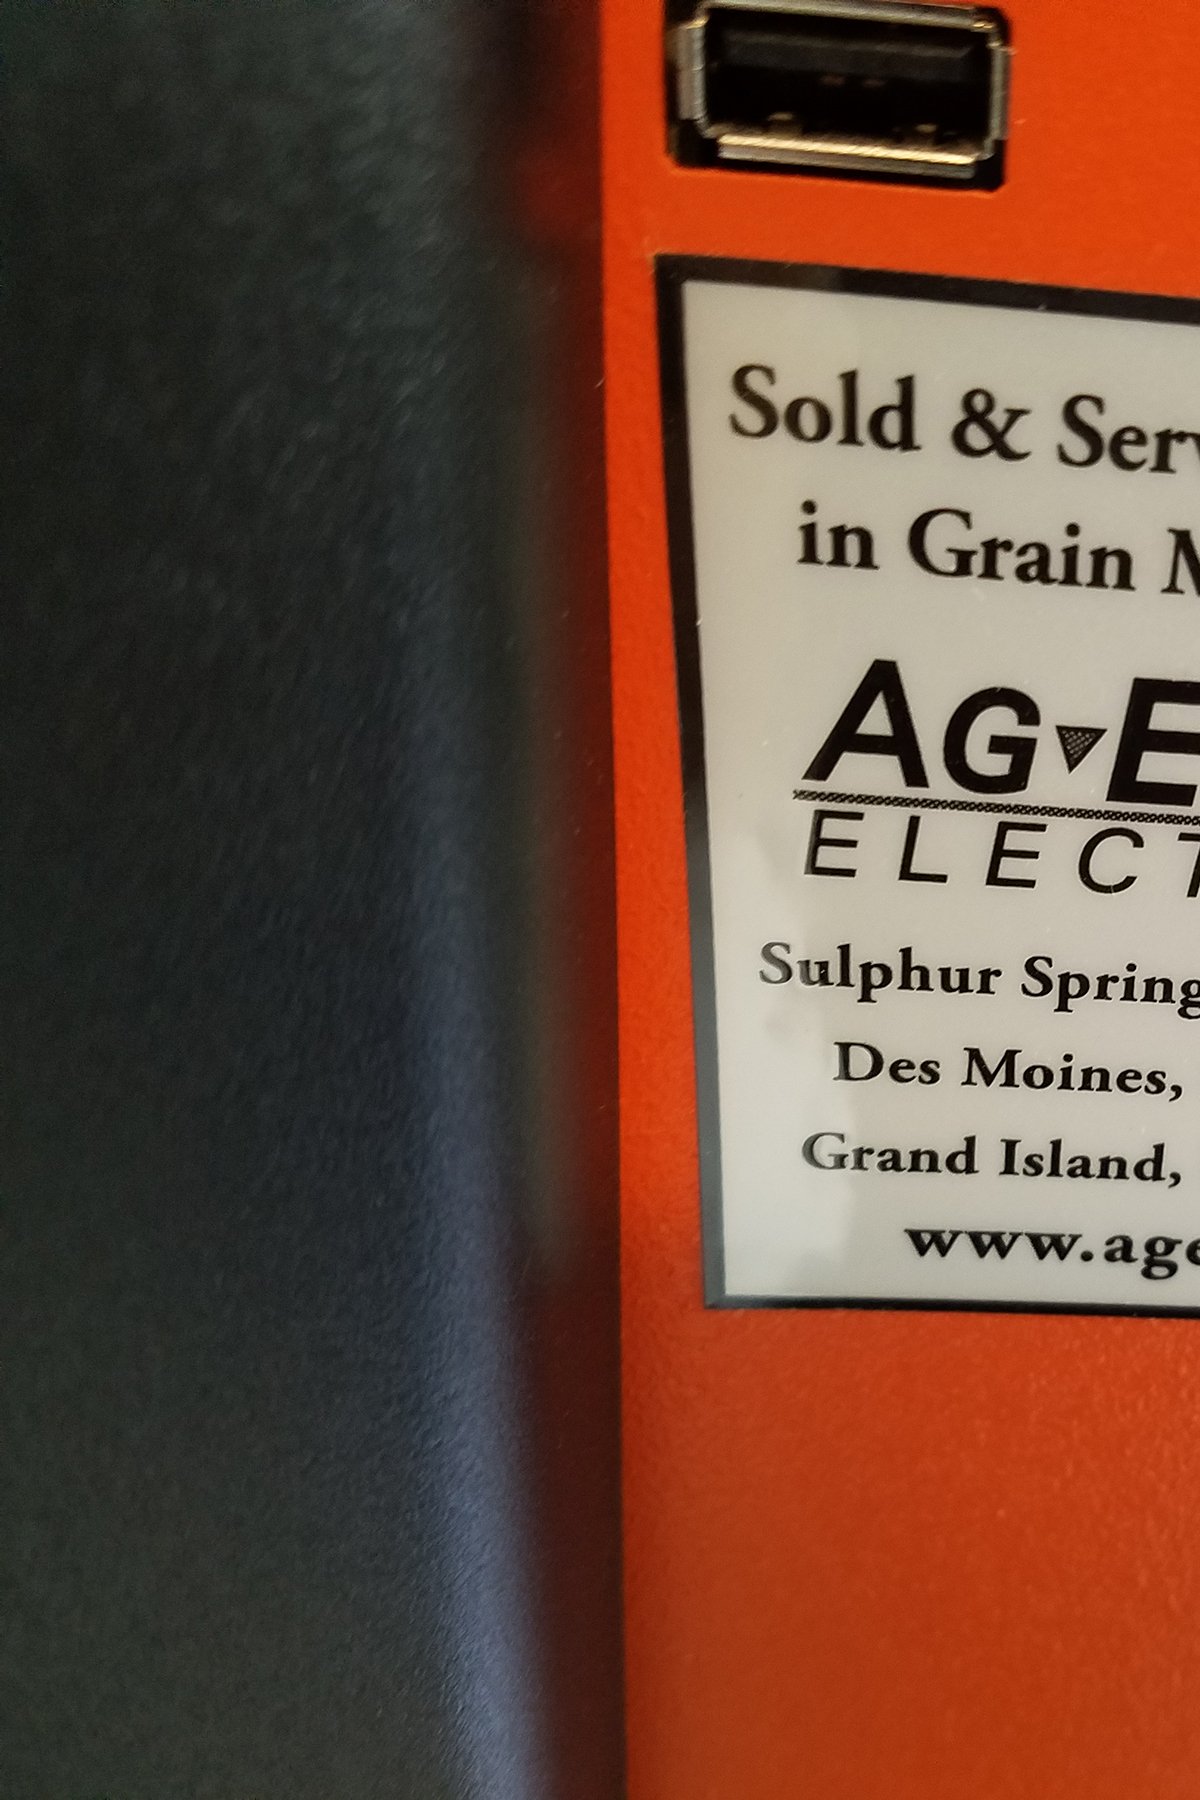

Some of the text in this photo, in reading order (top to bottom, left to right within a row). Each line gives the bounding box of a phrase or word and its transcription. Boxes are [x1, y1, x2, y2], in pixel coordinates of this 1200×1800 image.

[728, 363, 923, 454] Sold
[950, 386, 1033, 463] &
[796, 498, 880, 572] in
[906, 507, 1138, 593] Grain
[758, 941, 1003, 1005] Sulphur
[832, 1041, 942, 1086] Des
[960, 1046, 1183, 1103] Moines,
[801, 1130, 980, 1176] Grand
[998, 1138, 1182, 1189] Island,
